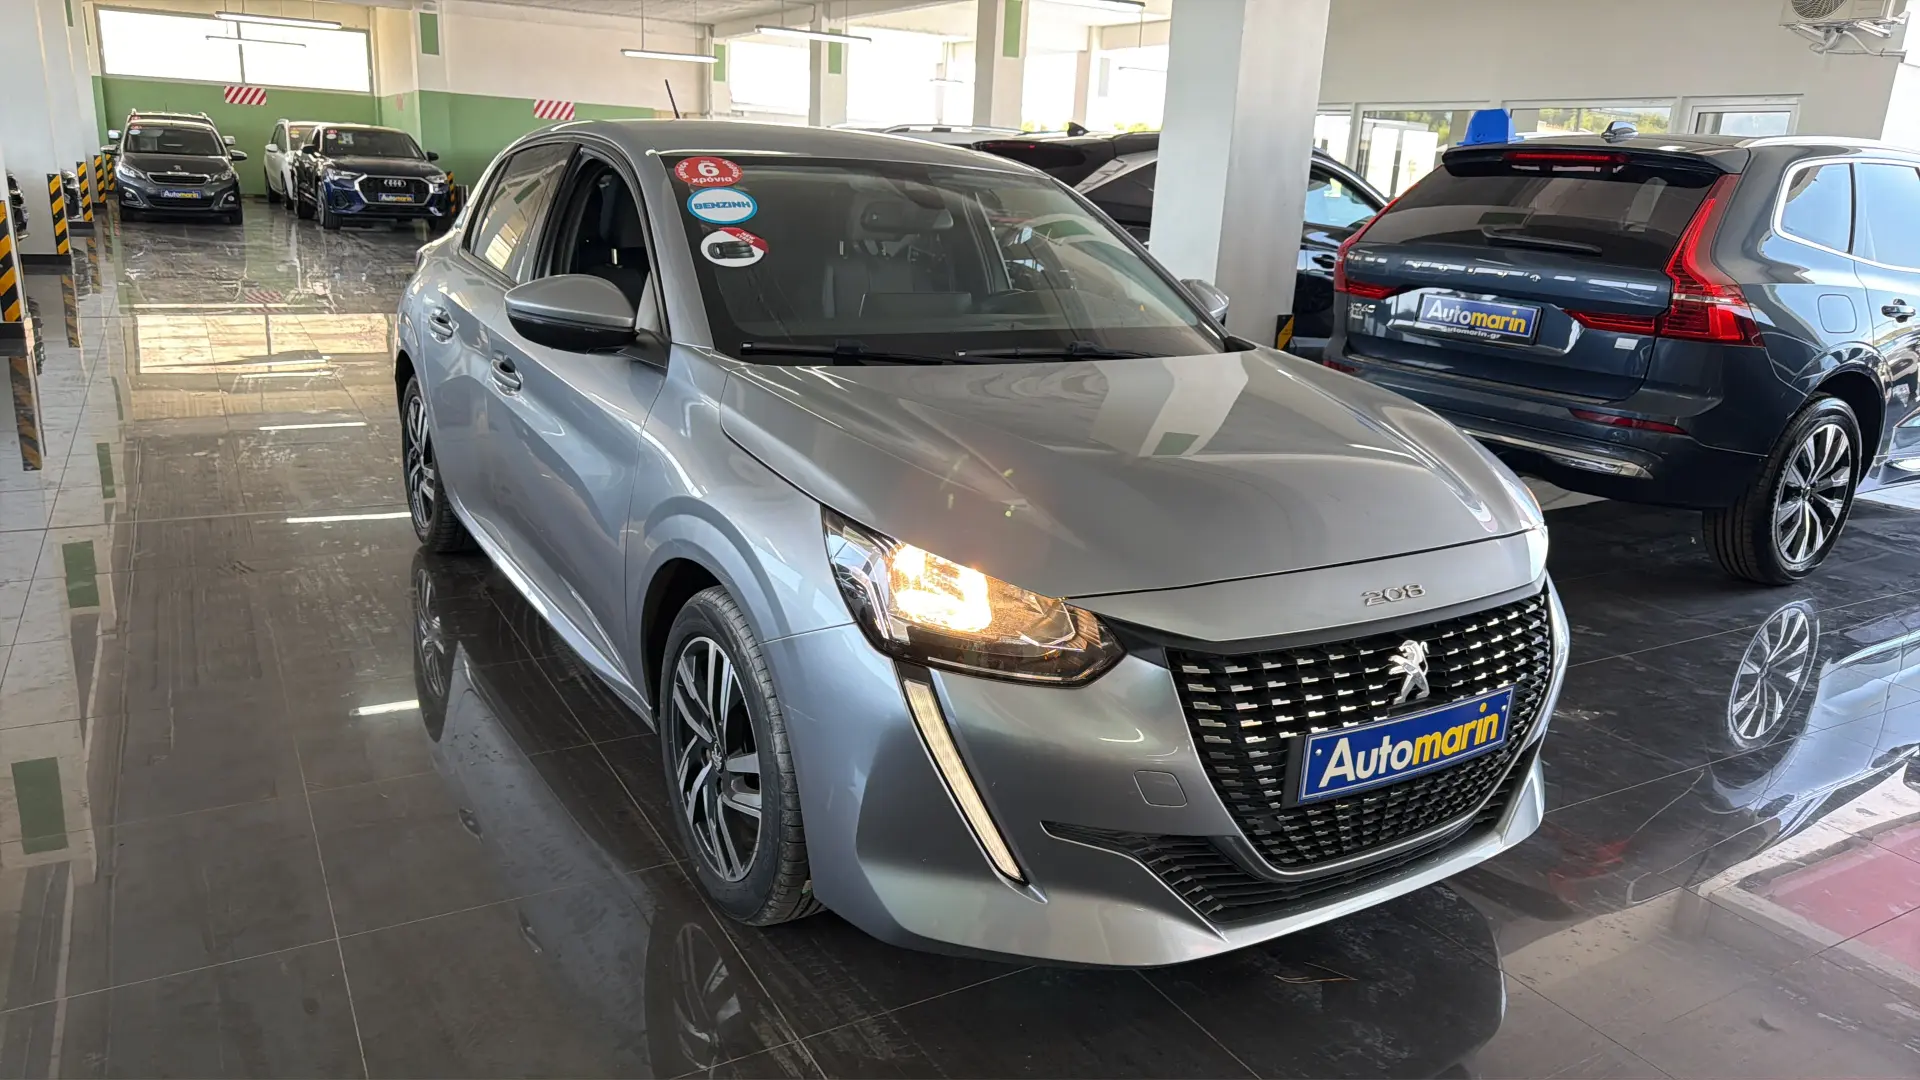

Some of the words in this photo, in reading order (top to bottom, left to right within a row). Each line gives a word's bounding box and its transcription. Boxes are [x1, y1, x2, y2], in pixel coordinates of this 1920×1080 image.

[698, 162, 719, 176] 6
[691, 176, 733, 184] χρόνια
[163, 190, 199, 198] Automarin
[1426, 299, 1527, 334] Automarin
[1361, 584, 1425, 606] 208
[1318, 702, 1500, 788] Automarin
